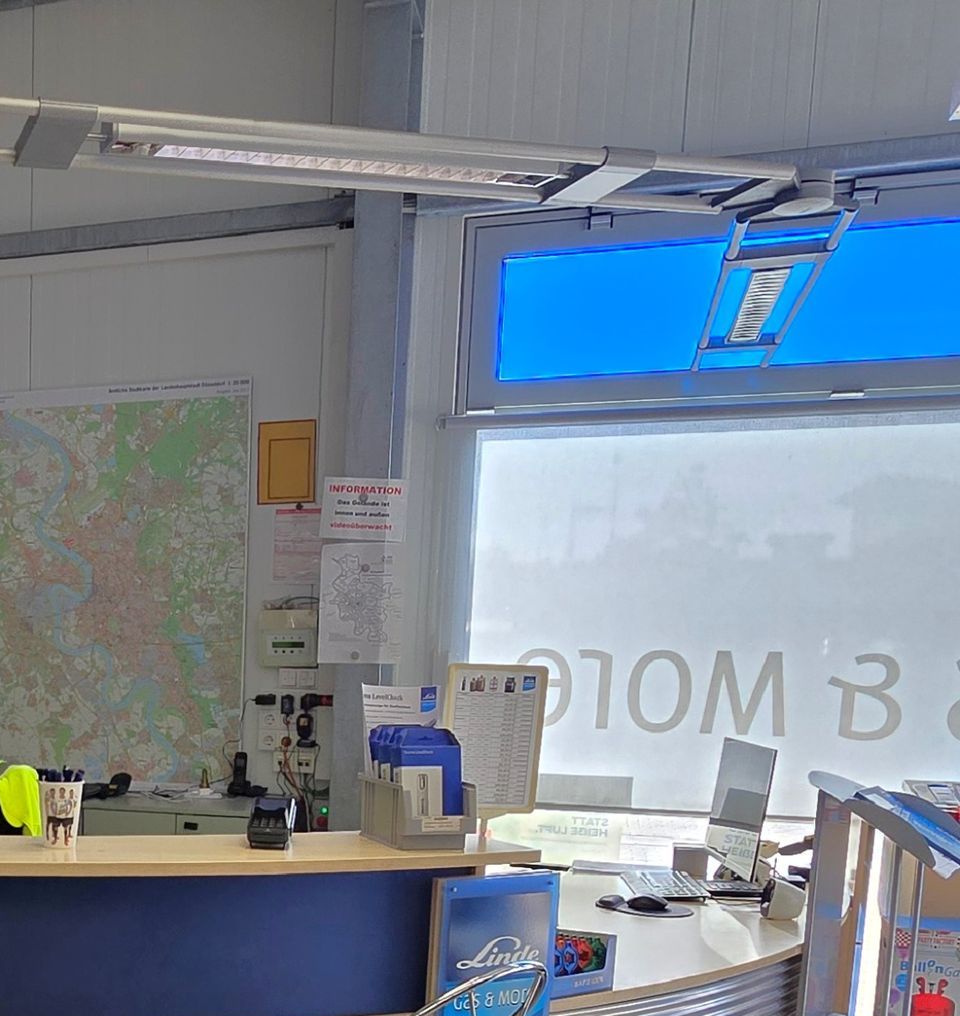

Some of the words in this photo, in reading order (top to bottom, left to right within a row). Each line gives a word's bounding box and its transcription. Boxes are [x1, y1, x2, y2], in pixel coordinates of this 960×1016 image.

[329, 484, 402, 495] INFORMATION
[330, 521, 392, 531] videoüberwacht
[456, 935, 539, 970] Linde
[484, 990, 494, 1009] &
